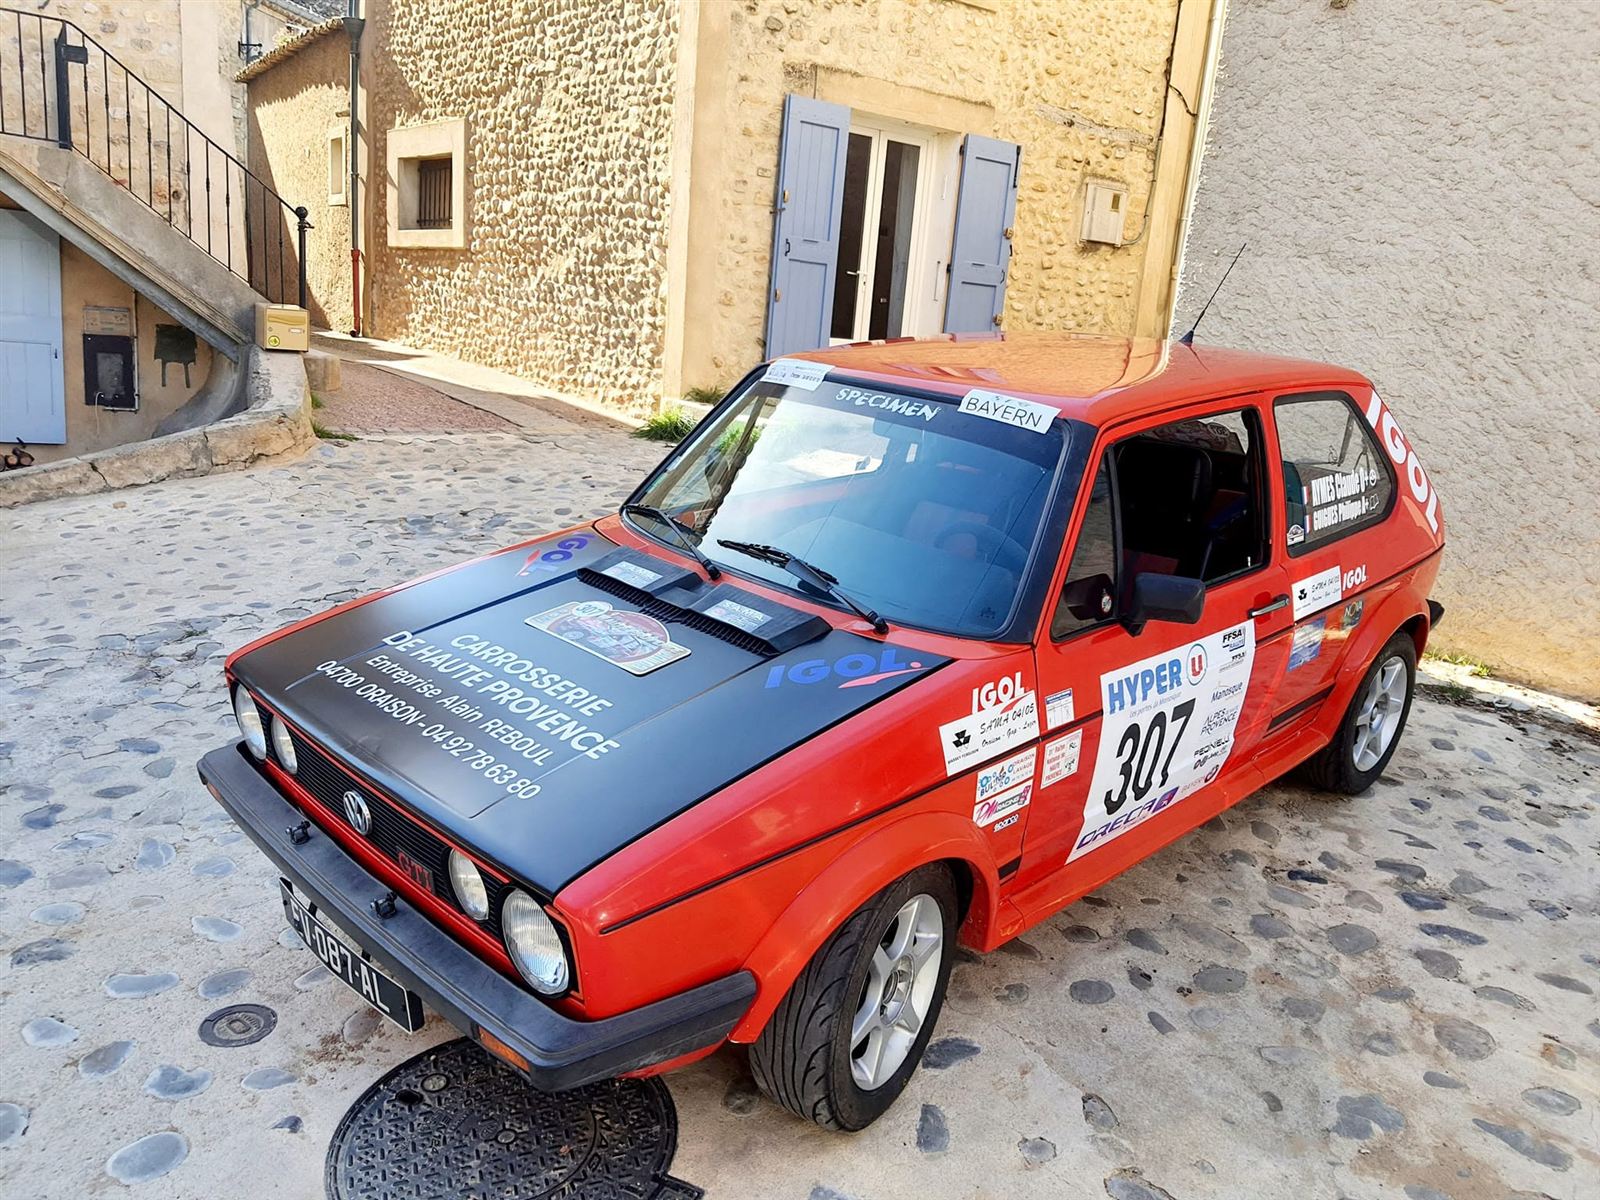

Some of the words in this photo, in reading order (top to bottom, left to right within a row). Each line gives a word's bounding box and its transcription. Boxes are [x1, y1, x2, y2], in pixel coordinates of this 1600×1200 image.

[834, 387, 938, 422] SPECIMEN
[965, 396, 1044, 428] BAYERN
[1366, 388, 1439, 535] IGOL
[1342, 564, 1367, 592] IGOL
[1222, 628, 1243, 644] FFSA
[316, 660, 365, 688] 04700
[356, 683, 427, 725] ORAISON
[381, 630, 426, 652] DE
[409, 645, 494, 688] HAUTE
[476, 680, 621, 760] PROVENCE
[450, 634, 614, 717] CARROSSERIE
[971, 671, 1025, 715] IGOL
[1108, 657, 1184, 716] HYPER
[1211, 682, 1243, 704] Manosque
[366, 654, 443, 698] Entreprise
[436, 695, 484, 723] Alain
[478, 718, 554, 767] REBOUL
[1200, 710, 1238, 736] PROVENCE
[1103, 697, 1197, 816] 307
[398, 851, 433, 893] GTI
